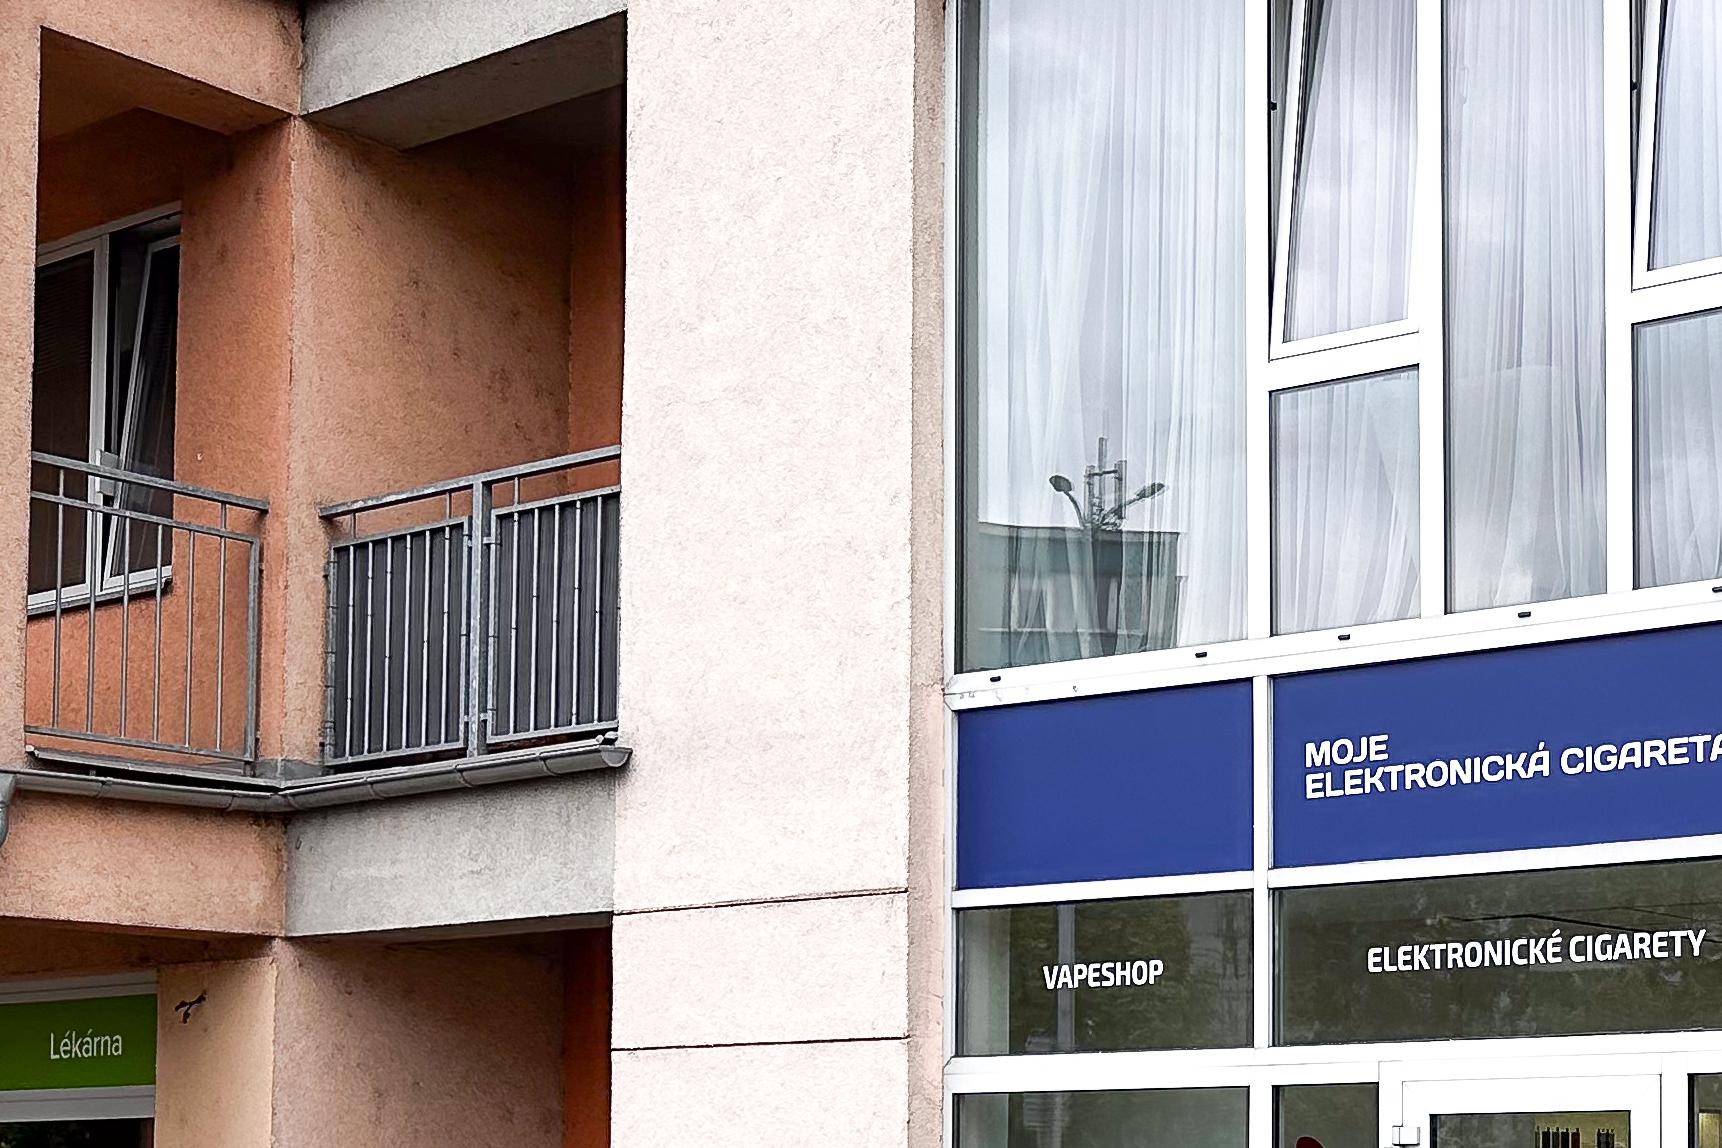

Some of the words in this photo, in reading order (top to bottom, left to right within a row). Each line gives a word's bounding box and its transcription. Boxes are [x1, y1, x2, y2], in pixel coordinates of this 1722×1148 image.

[1305, 734, 1389, 768] MOJE
[1305, 741, 1551, 800] ELEKTRONICKÁ
[1367, 929, 1563, 973] ELEKTRONICKÉ
[1568, 929, 1707, 963] CIGARETY
[1042, 959, 1164, 990] VAPESHOP
[49, 1028, 123, 1060] Lékárna
